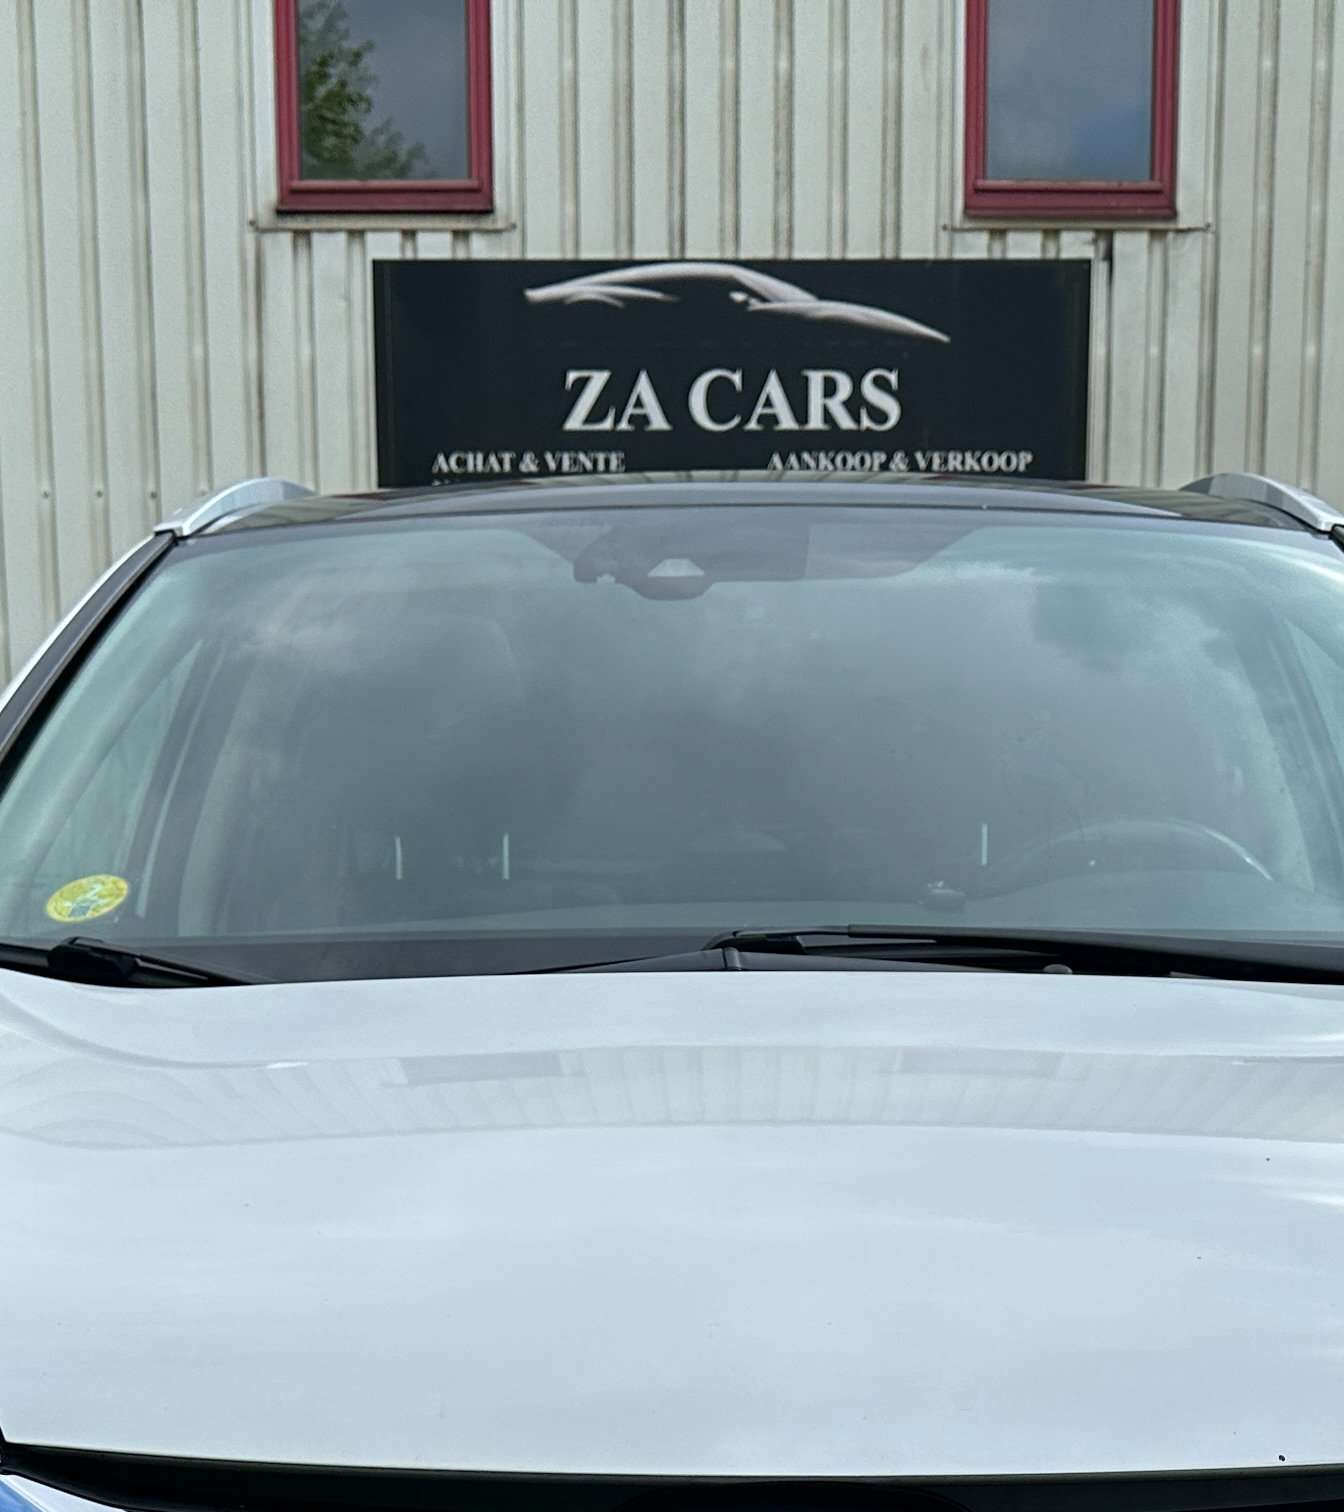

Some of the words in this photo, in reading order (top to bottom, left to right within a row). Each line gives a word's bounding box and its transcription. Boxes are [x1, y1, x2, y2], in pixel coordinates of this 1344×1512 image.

[563, 368, 671, 432] ZA
[688, 367, 902, 432] CARS
[431, 451, 515, 474] ACHAT
[518, 451, 539, 473] &
[544, 451, 626, 473] VENTE
[767, 451, 887, 472] AANKOOP
[888, 451, 908, 472] &
[914, 451, 1033, 473] VERKOOP
